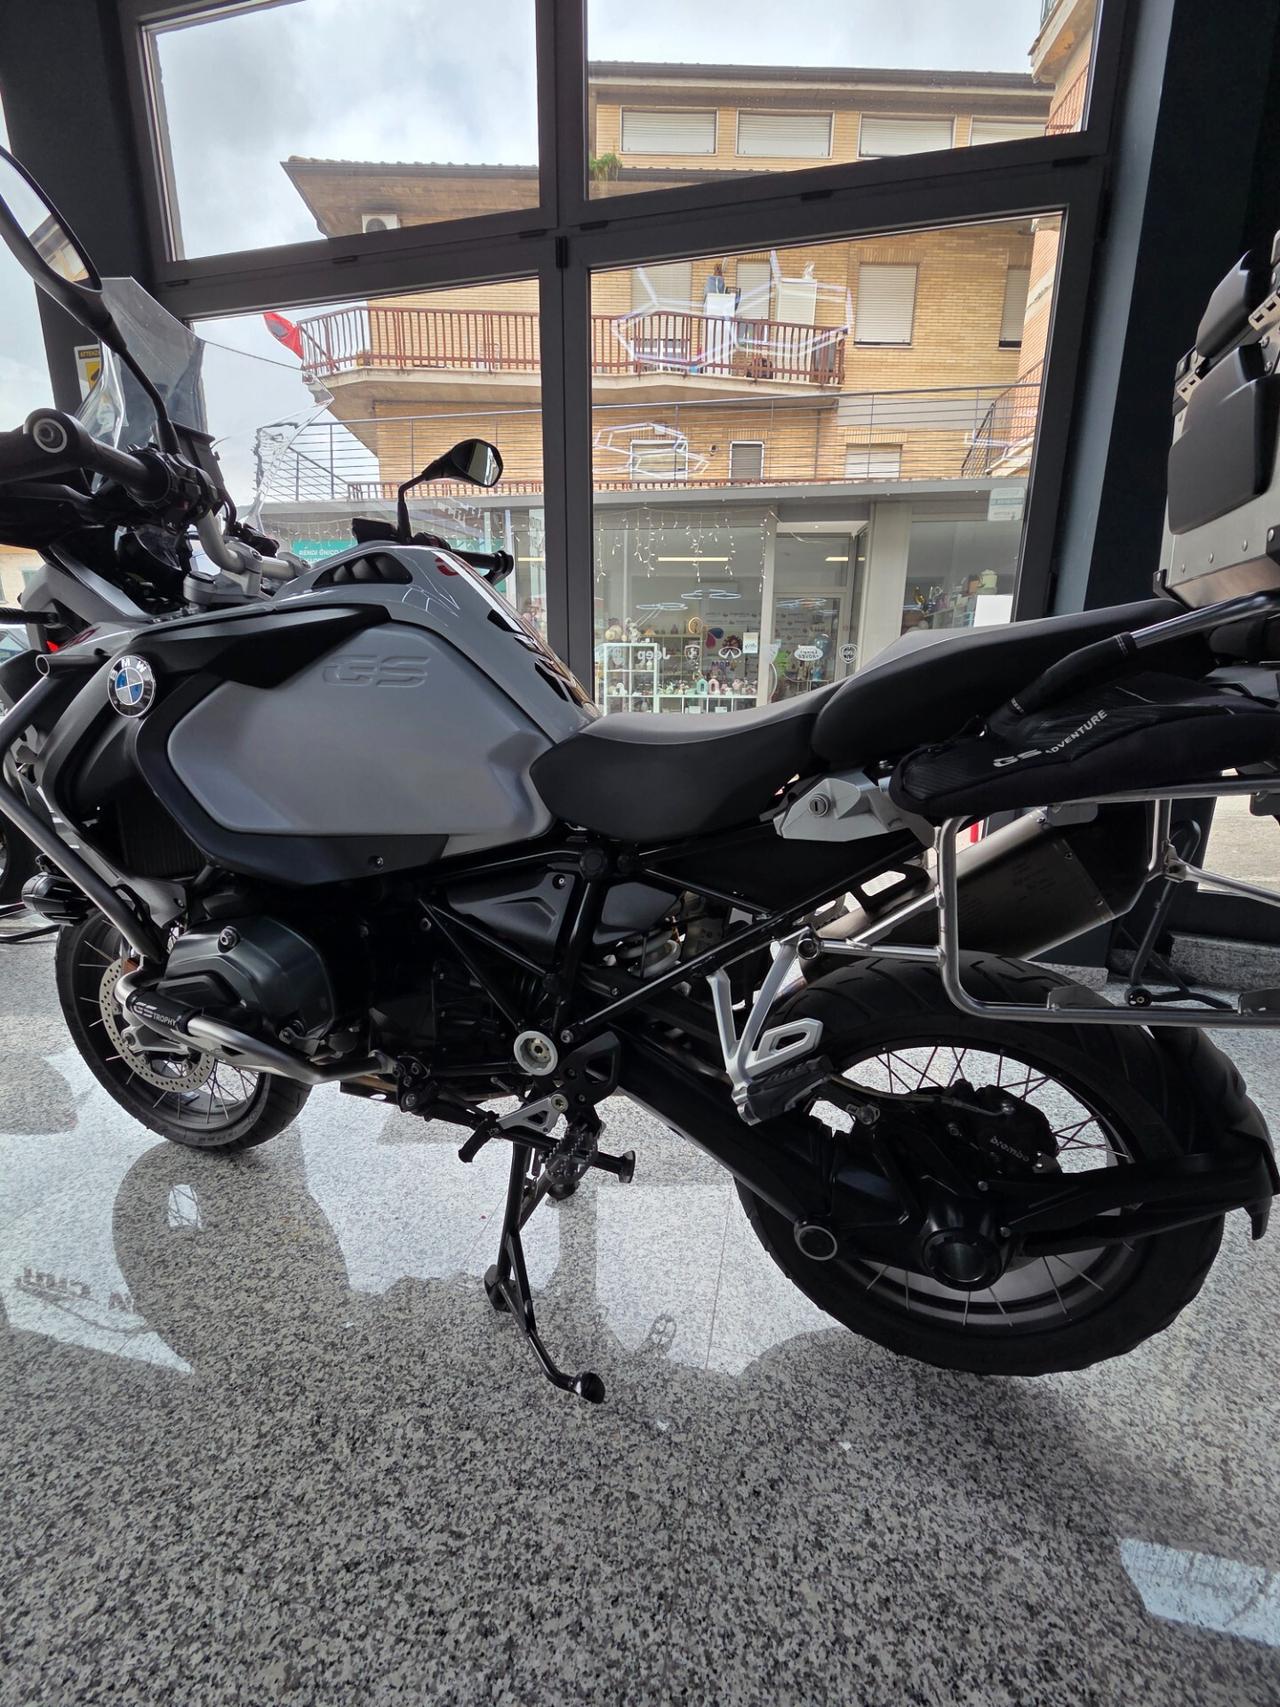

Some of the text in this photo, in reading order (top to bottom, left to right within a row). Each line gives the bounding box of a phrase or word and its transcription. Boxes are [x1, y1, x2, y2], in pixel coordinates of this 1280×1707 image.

[322, 654, 431, 688] GS
[153, 1012, 177, 1027] TROPHY
[990, 1136, 1030, 1162] brembo
